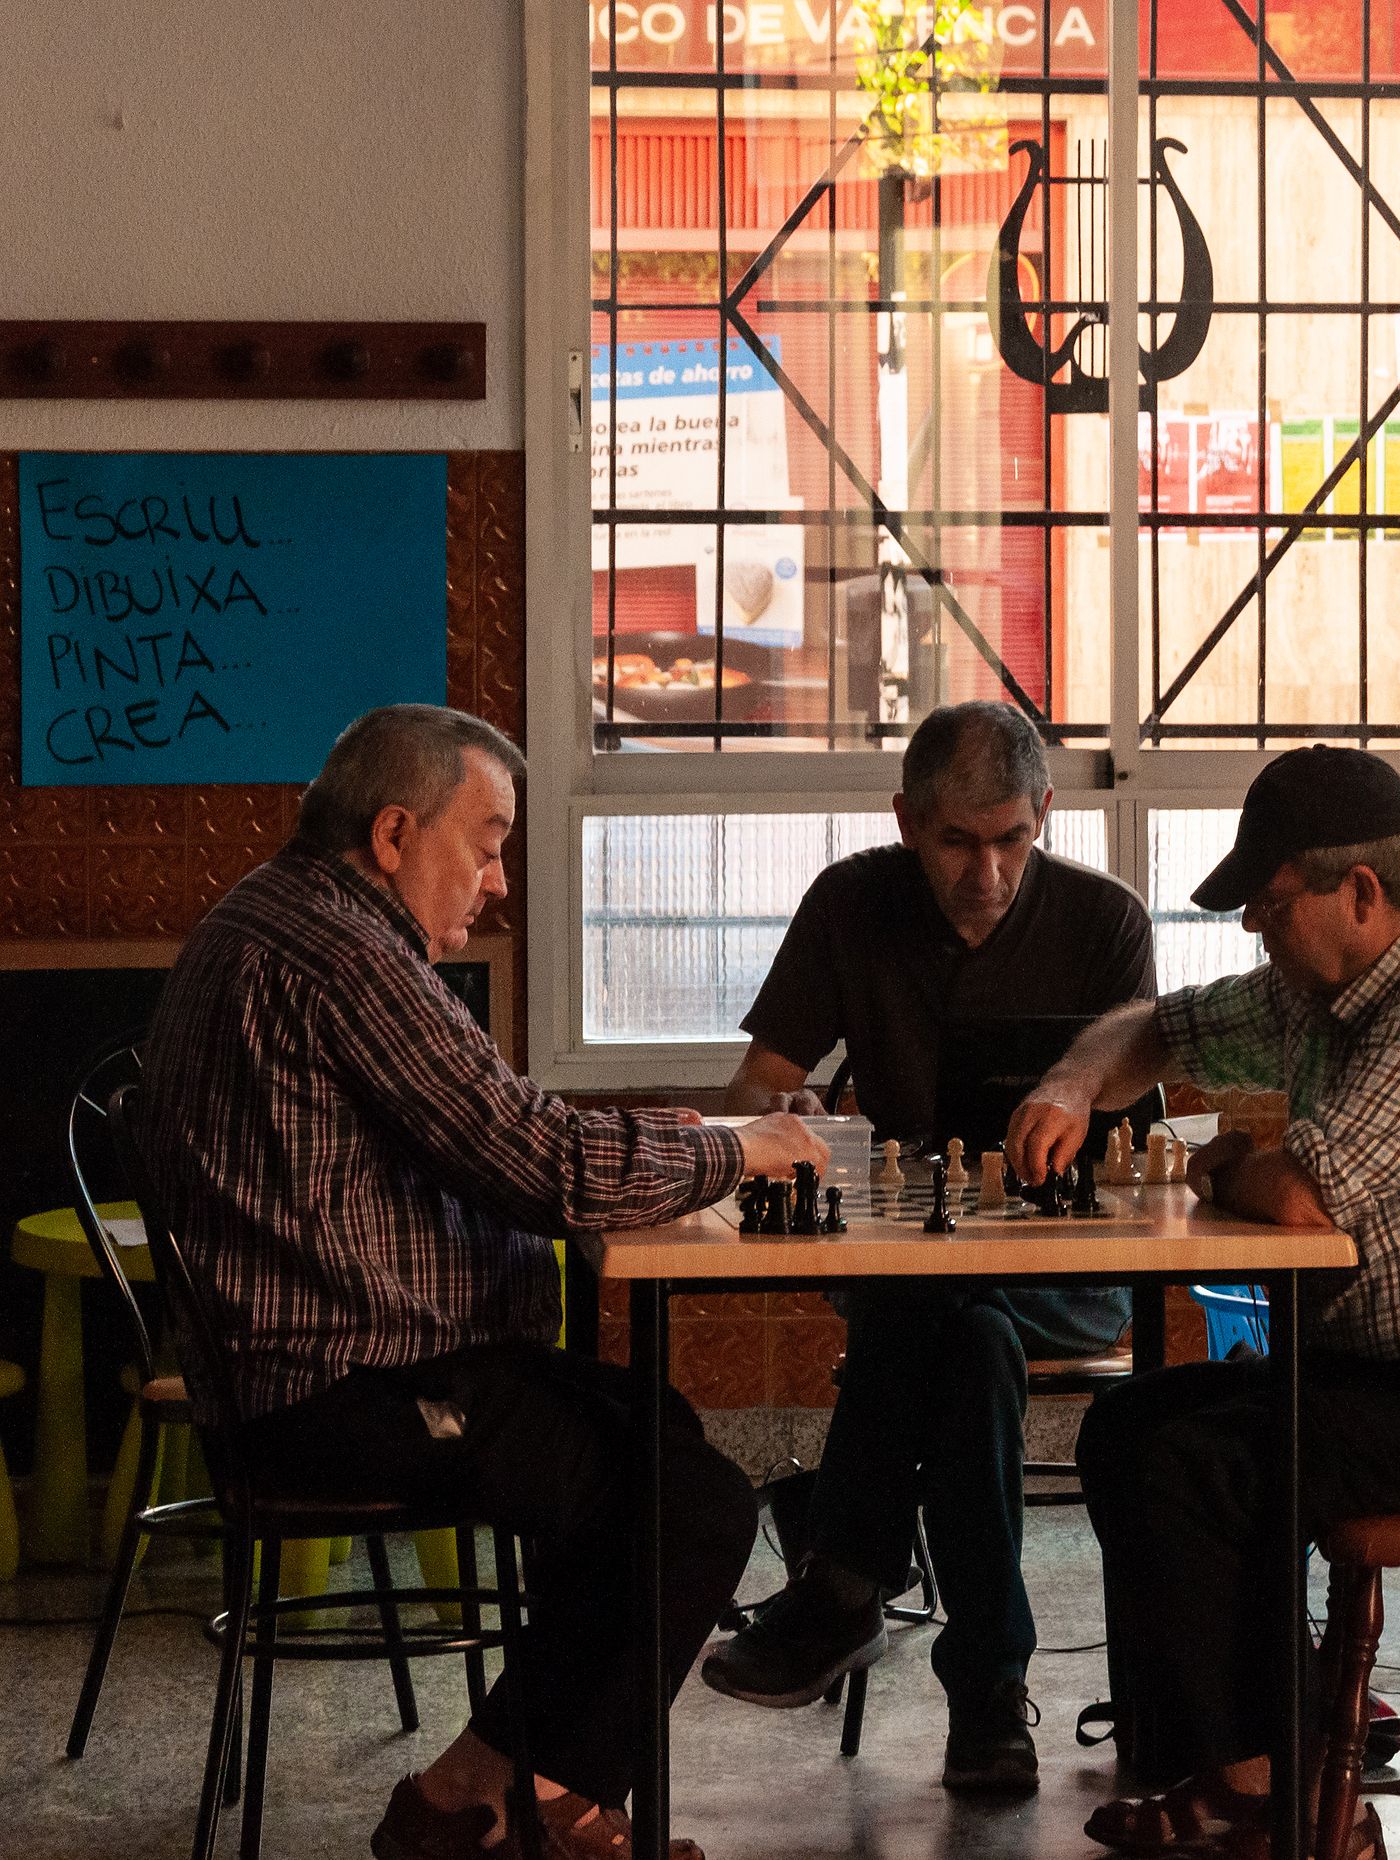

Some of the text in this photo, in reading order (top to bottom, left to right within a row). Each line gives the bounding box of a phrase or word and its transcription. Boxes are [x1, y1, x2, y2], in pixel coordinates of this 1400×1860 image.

[707, 3, 785, 44] DE
[793, 0, 1096, 47] VAENCA
[649, 365, 675, 385] de
[681, 363, 753, 384] ahoro
[650, 416, 666, 432] la
[591, 464, 638, 478] oras
